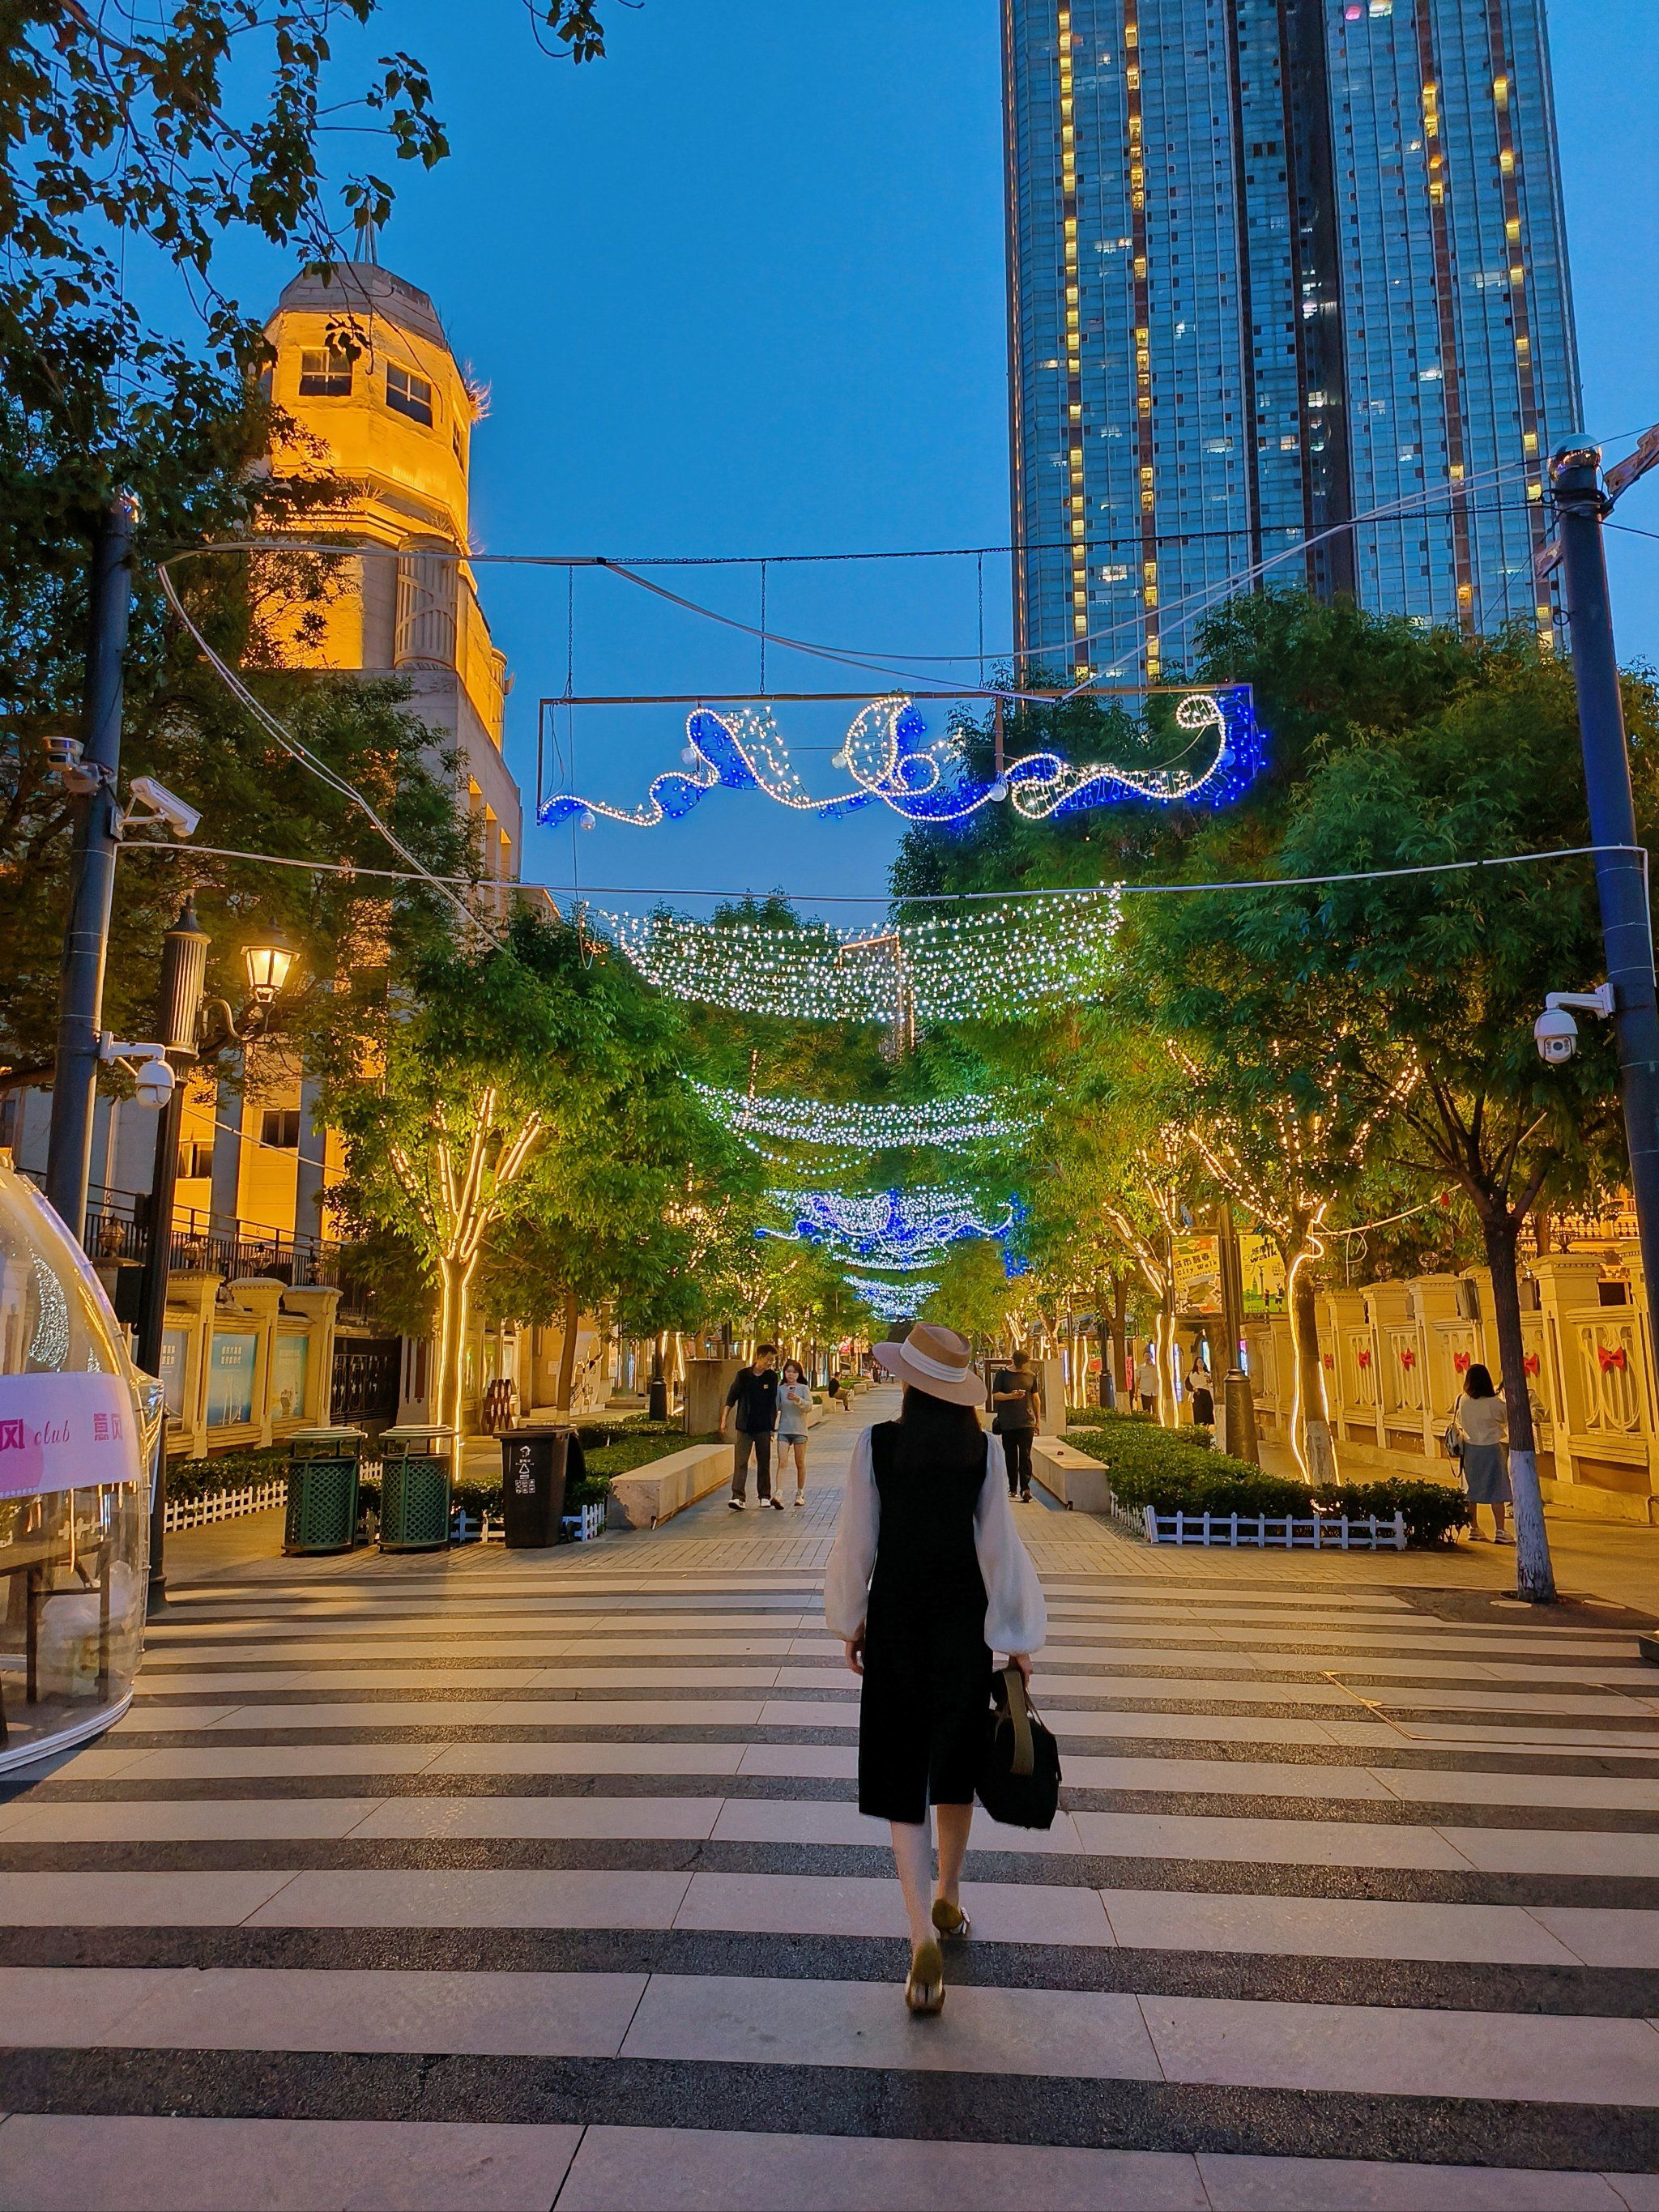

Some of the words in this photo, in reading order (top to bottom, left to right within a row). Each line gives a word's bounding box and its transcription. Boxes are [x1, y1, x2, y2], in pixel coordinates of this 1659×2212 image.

[1174, 1253, 1209, 1269] 城市
[1250, 1242, 1277, 1263] walk
[1177, 1268, 1194, 1276] City
[1196, 1259, 1217, 1270] Walk
[34, 1420, 70, 1446] club
